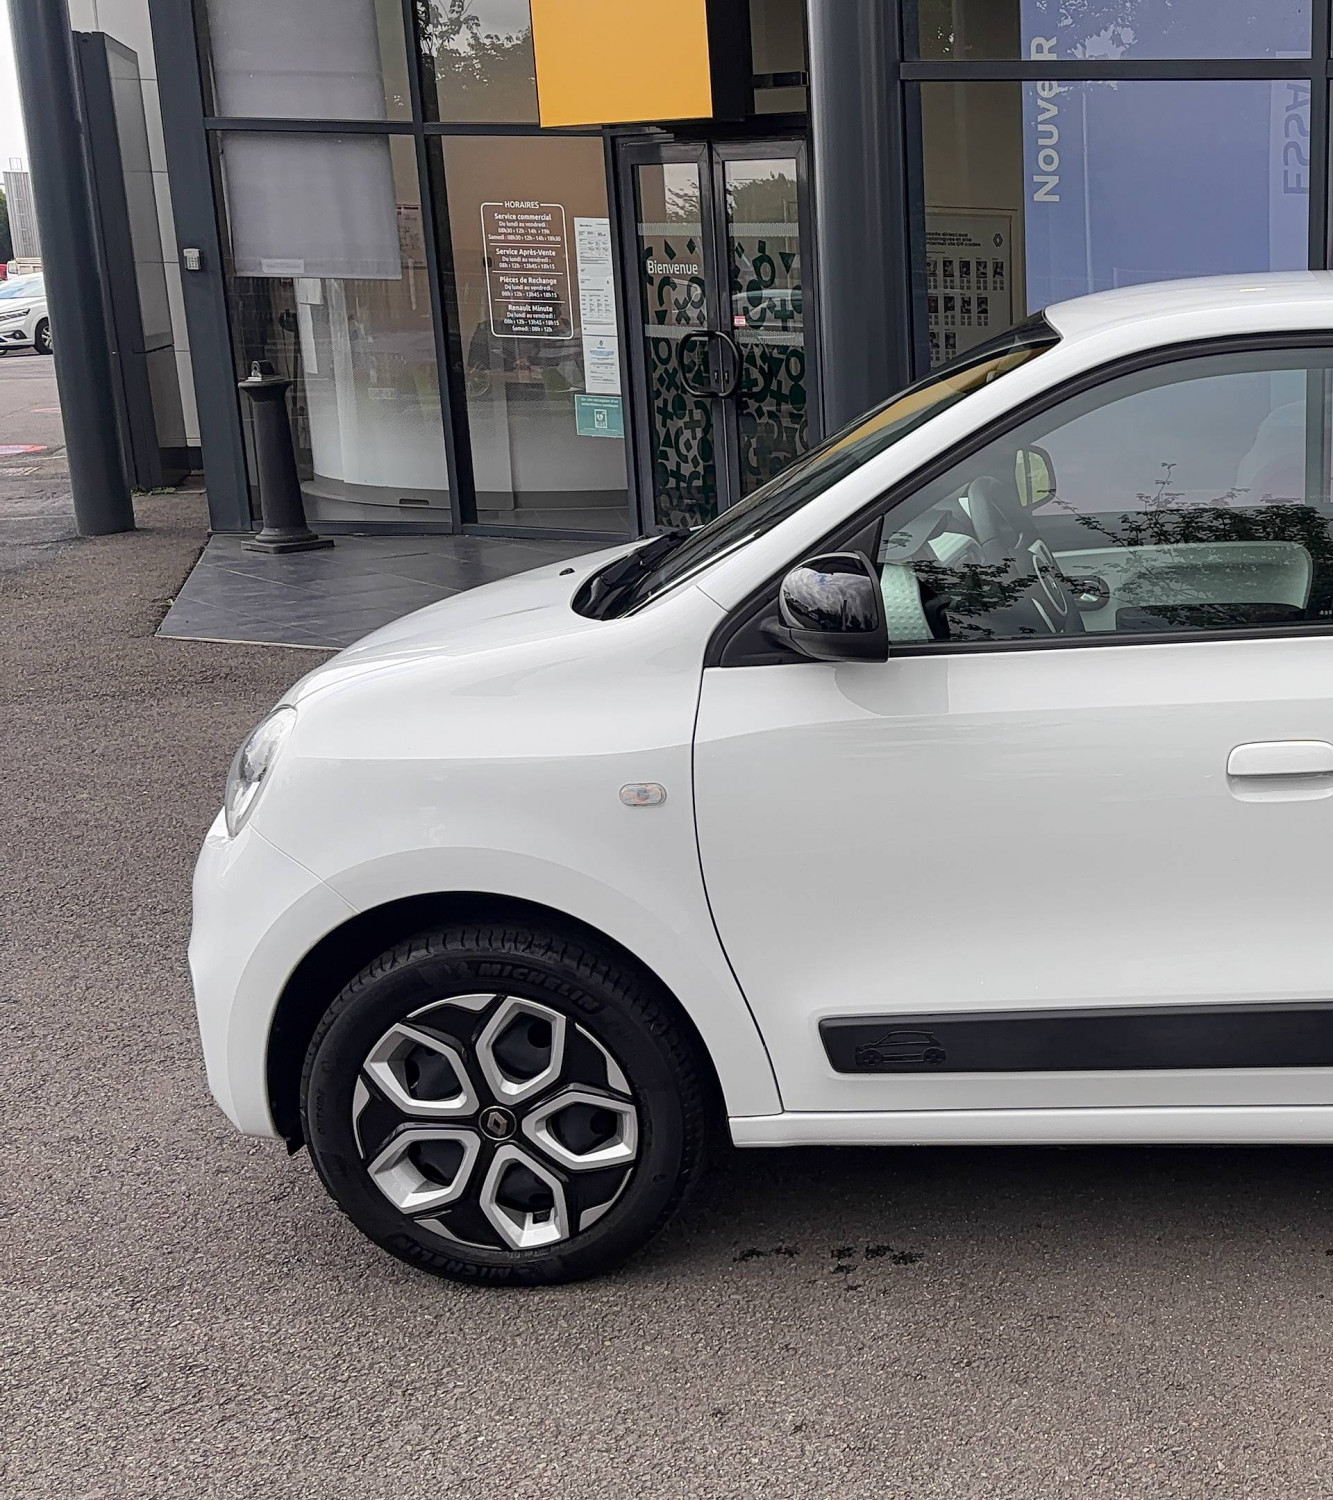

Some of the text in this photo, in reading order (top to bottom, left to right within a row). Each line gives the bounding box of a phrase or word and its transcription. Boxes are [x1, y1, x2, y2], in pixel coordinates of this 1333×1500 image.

[528, 277, 557, 285] Rechange
[647, 260, 698, 274] Bienvenue
[478, 962, 601, 1012] MICHELIN
[392, 1236, 512, 1281] MICHELIN
